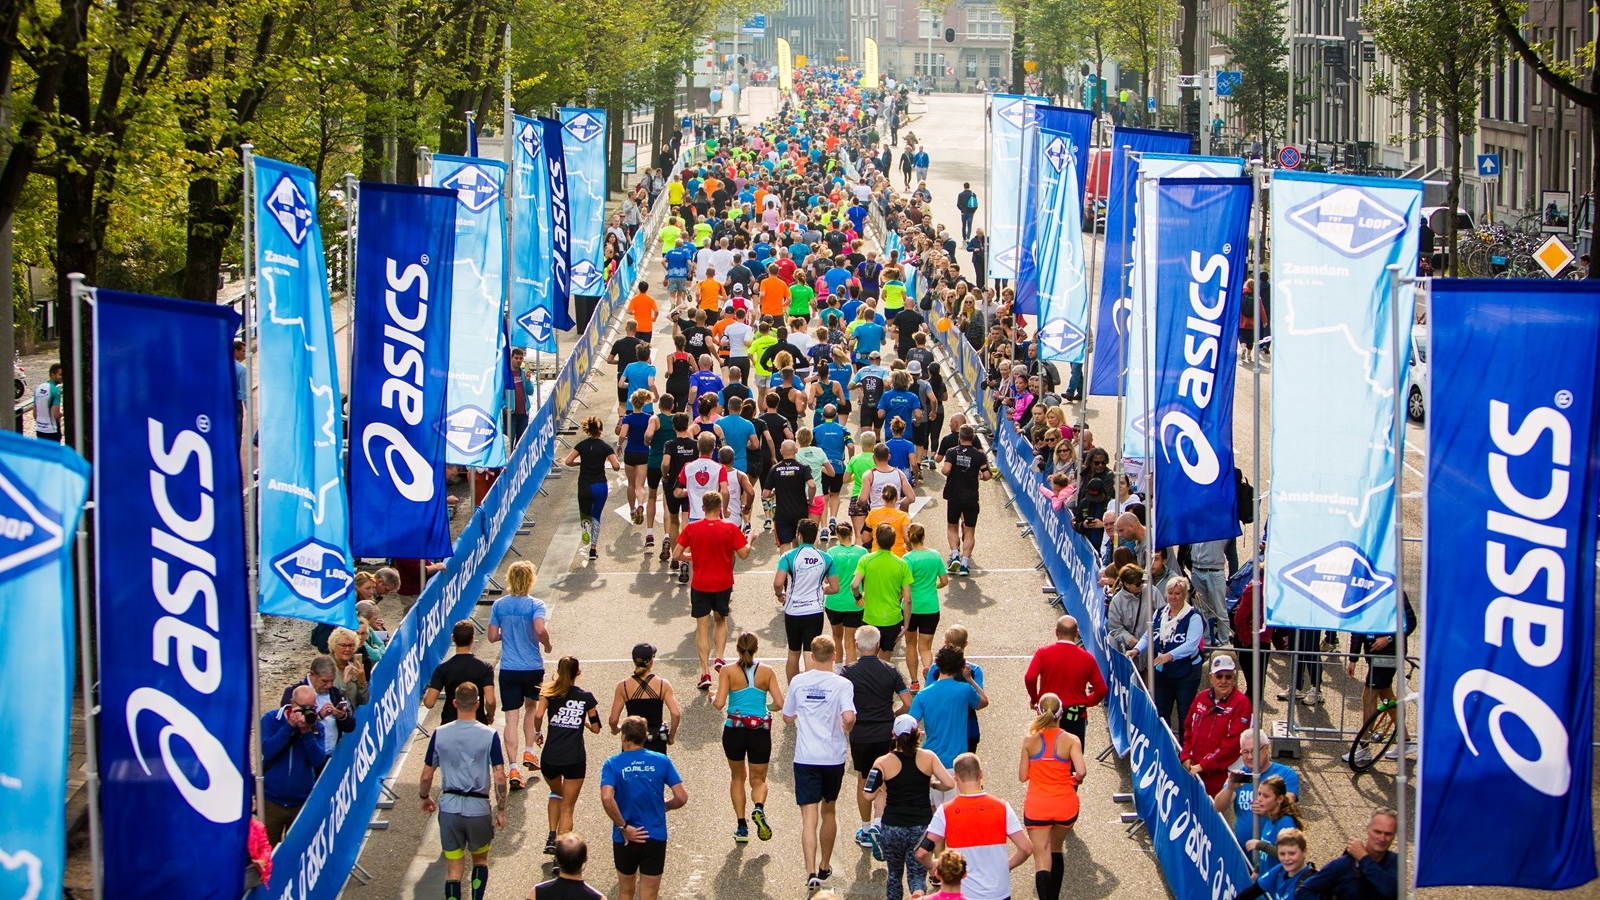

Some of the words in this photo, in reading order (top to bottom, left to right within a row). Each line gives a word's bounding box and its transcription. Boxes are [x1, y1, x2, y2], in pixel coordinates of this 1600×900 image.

[549, 157, 567, 252] asics
[1358, 217, 1392, 230] LOOP
[1282, 262, 1350, 278] Zaandam
[381, 257, 429, 426] asics
[1177, 249, 1230, 410] asics
[474, 426, 494, 436] LOOP
[1278, 489, 1359, 506] Amsterdam
[148, 416, 223, 695] asics
[1484, 399, 1572, 668] asics
[299, 555, 319, 569] DAM
[804, 557, 819, 565] TOP
[445, 573, 458, 617] asics
[426, 599, 442, 647] asics
[403, 643, 419, 695] asics
[380, 679, 400, 735] asics
[550, 714, 583, 726] AHEAD
[557, 706, 584, 717] STEP
[565, 699, 586, 709] ONE
[356, 720, 377, 783] asics
[335, 766, 352, 834] asics
[307, 817, 328, 892] asics
[1185, 813, 1212, 883] asics
